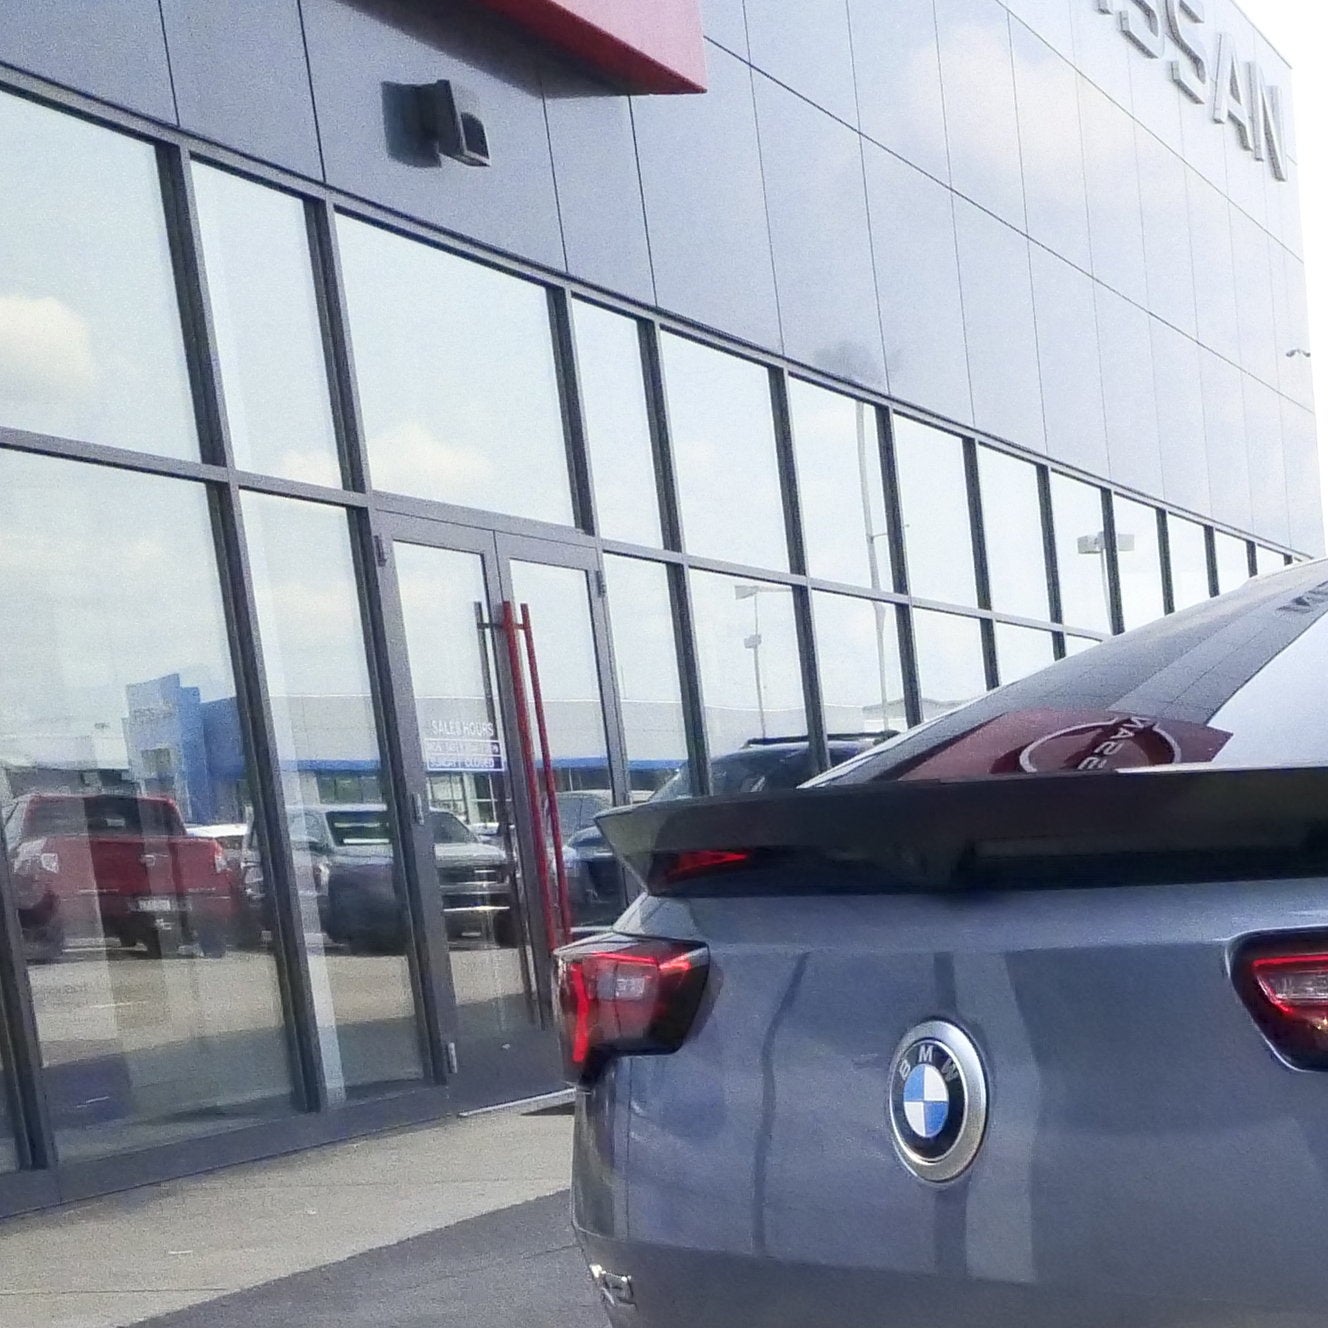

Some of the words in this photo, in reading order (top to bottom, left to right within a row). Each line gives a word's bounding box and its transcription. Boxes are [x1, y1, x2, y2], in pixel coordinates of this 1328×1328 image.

[1092, 0, 1287, 182] SSAN
[462, 721, 494, 737] HOURS
[900, 1045, 959, 1082] BMW
